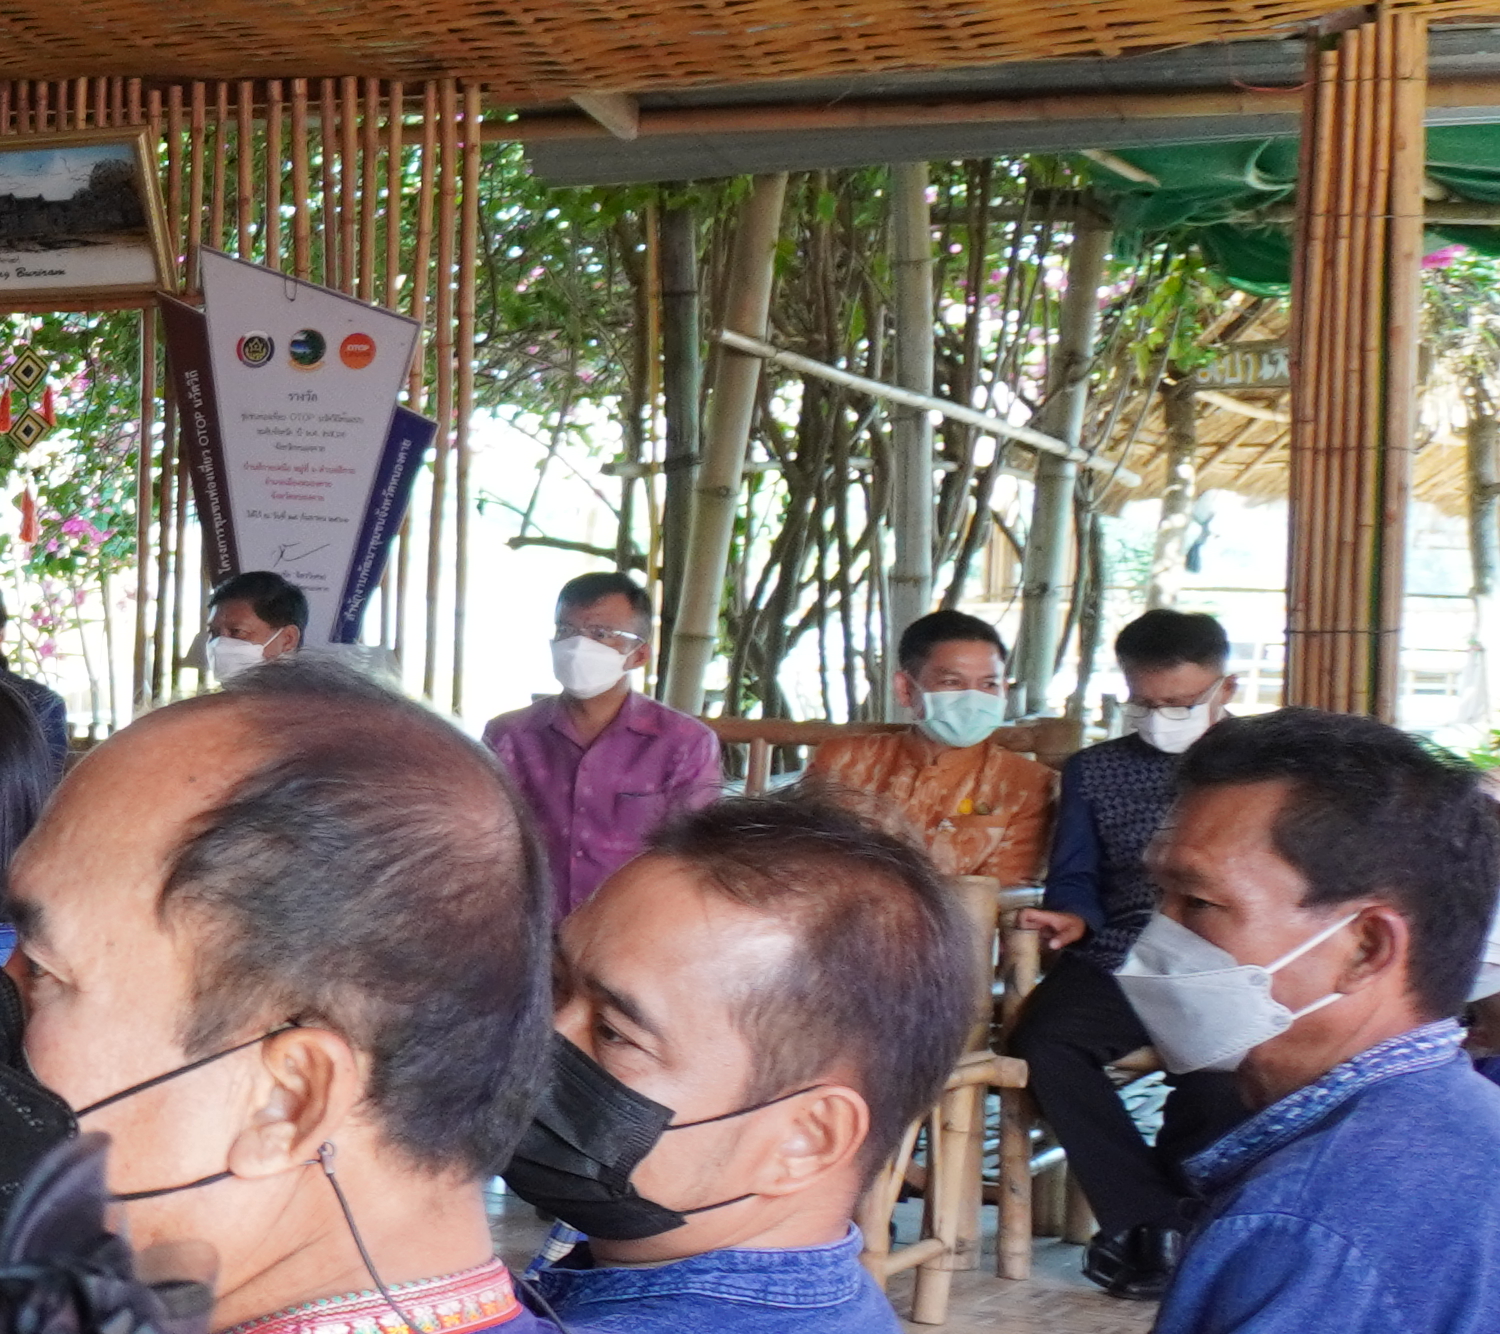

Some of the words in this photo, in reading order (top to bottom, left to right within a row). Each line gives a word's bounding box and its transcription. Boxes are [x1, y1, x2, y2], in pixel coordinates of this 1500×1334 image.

[288, 389, 318, 402] รางวัล
[194, 410, 210, 446] OTOP
